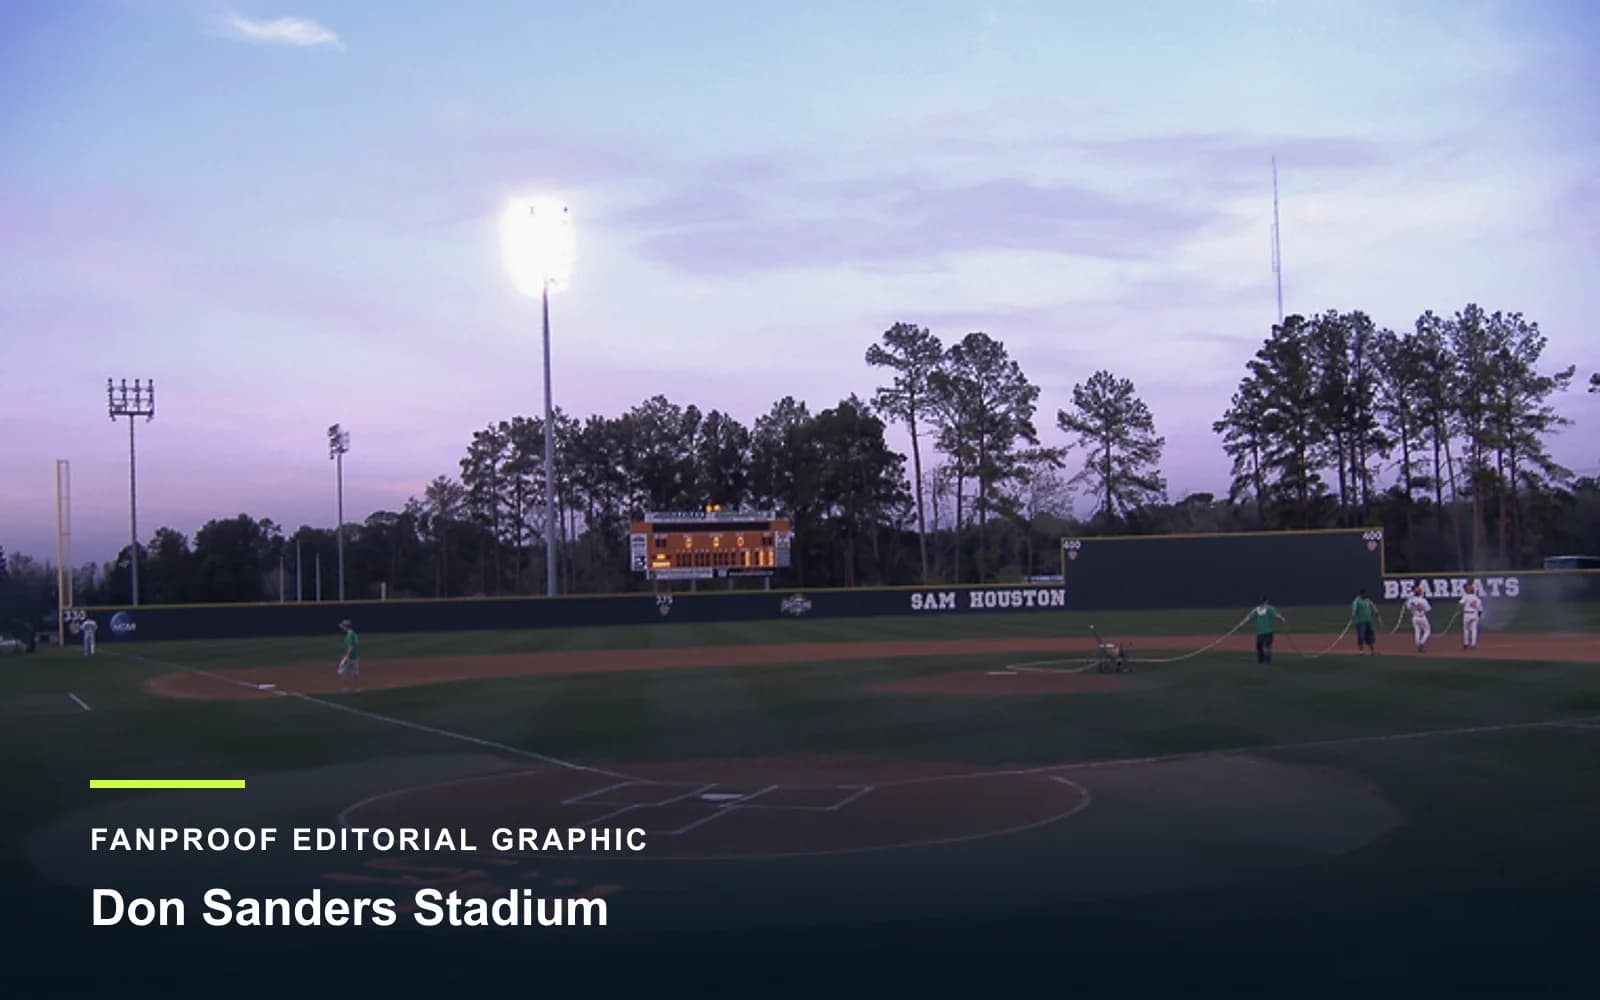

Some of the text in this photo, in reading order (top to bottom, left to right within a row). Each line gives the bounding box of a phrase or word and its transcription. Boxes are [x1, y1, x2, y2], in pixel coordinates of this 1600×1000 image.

[1364, 530, 1382, 540] 400
[1063, 540, 1081, 549] 400
[1384, 577, 1519, 599] BEARKATS
[911, 589, 1066, 609] SAM HOUSTON
